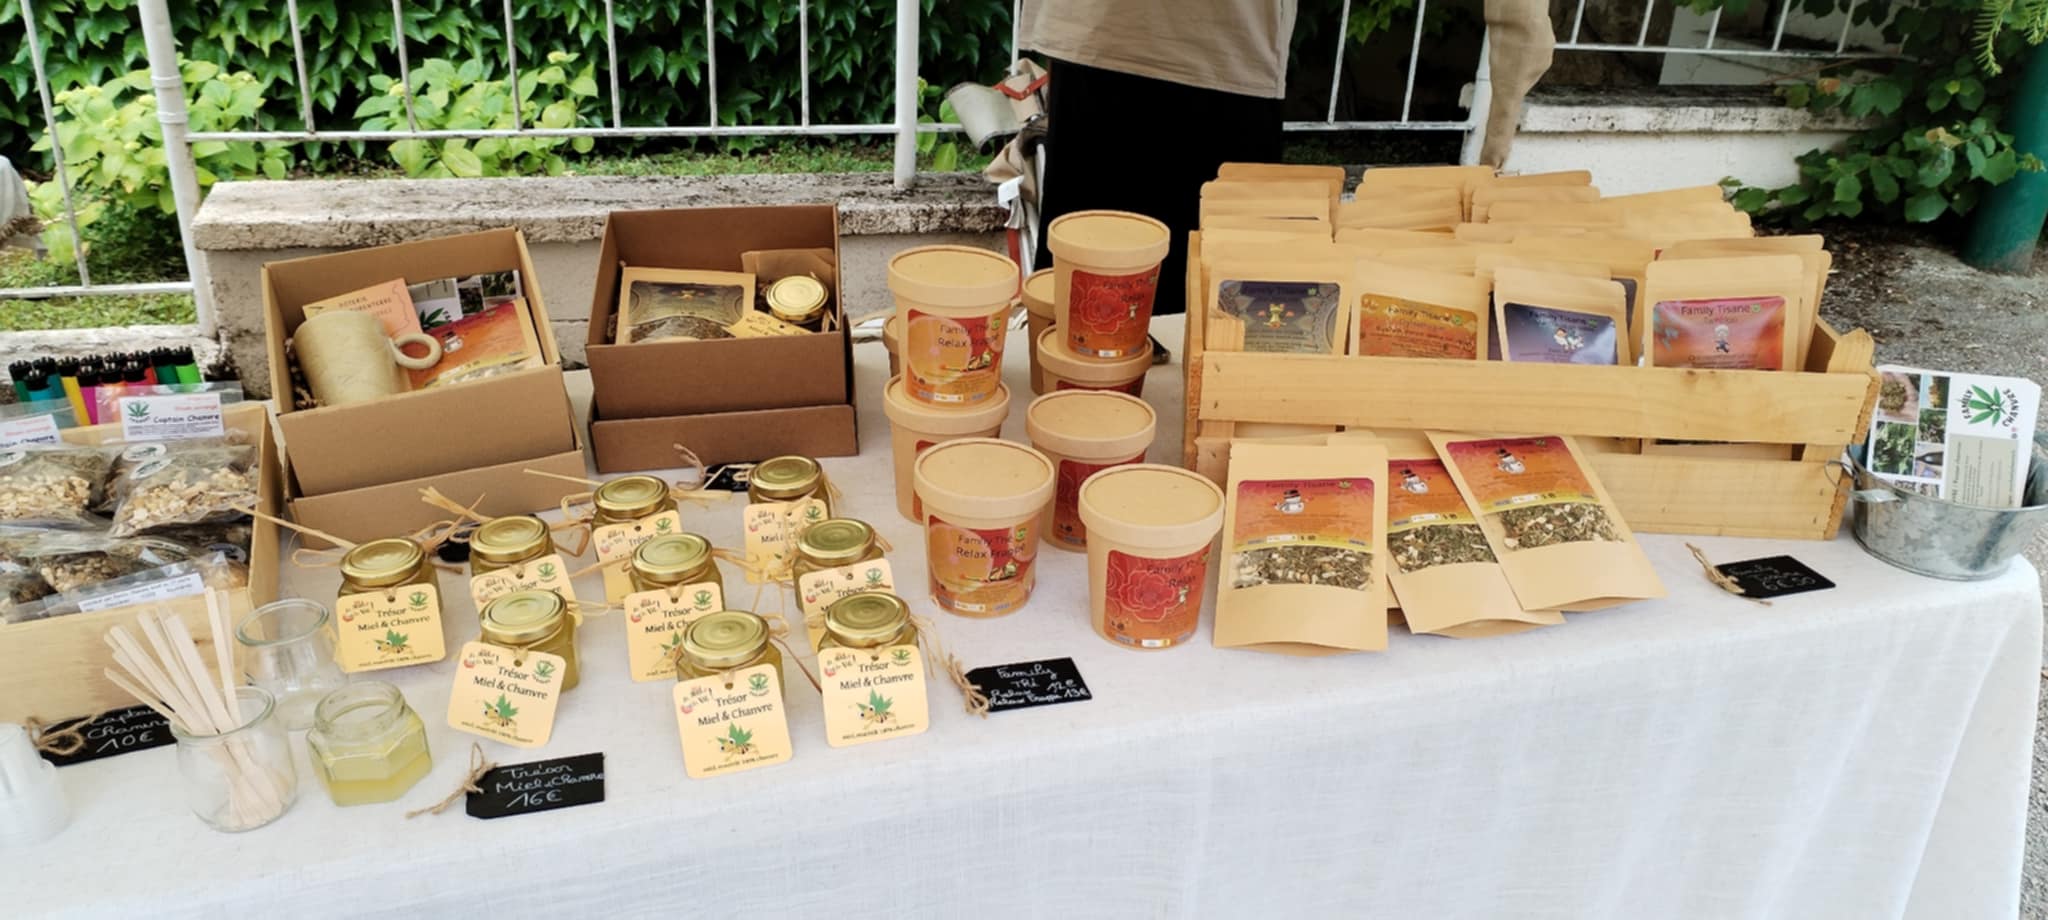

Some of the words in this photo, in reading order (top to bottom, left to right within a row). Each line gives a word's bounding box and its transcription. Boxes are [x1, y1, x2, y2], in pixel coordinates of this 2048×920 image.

[1388, 306, 1419, 317] Family
[1681, 305, 1714, 316] Family
[1717, 304, 1751, 313] Tisane
[940, 324, 970, 335] Family
[938, 336, 967, 348] Relax
[1961, 389, 1973, 420] FAMILY
[2002, 387, 2020, 428] CHANVRE
[153, 415, 184, 425] Captain
[958, 534, 992, 547] Family
[956, 546, 987, 559] Relax
[377, 607, 406, 618] Trésor
[663, 607, 692, 618] Trésor
[358, 620, 380, 632] Miel
[381, 621, 389, 629] &
[390, 615, 430, 628] Chanvre
[645, 622, 666, 634] Miel
[667, 621, 675, 631] &
[498, 666, 529, 681] Trésor
[859, 662, 890, 673] Trésor
[473, 676, 496, 689] Miel
[496, 681, 506, 691] &
[507, 684, 549, 700] Chanvre
[840, 678, 862, 690] Miel
[863, 677, 872, 687] &
[873, 673, 914, 686] Chanvre
[716, 693, 748, 707] Trésor
[698, 712, 721, 726] Miel
[722, 710, 729, 721] &
[731, 703, 773, 719] Chanvre
[495, 779, 542, 793] Miel
[506, 788, 563, 808] 16€
